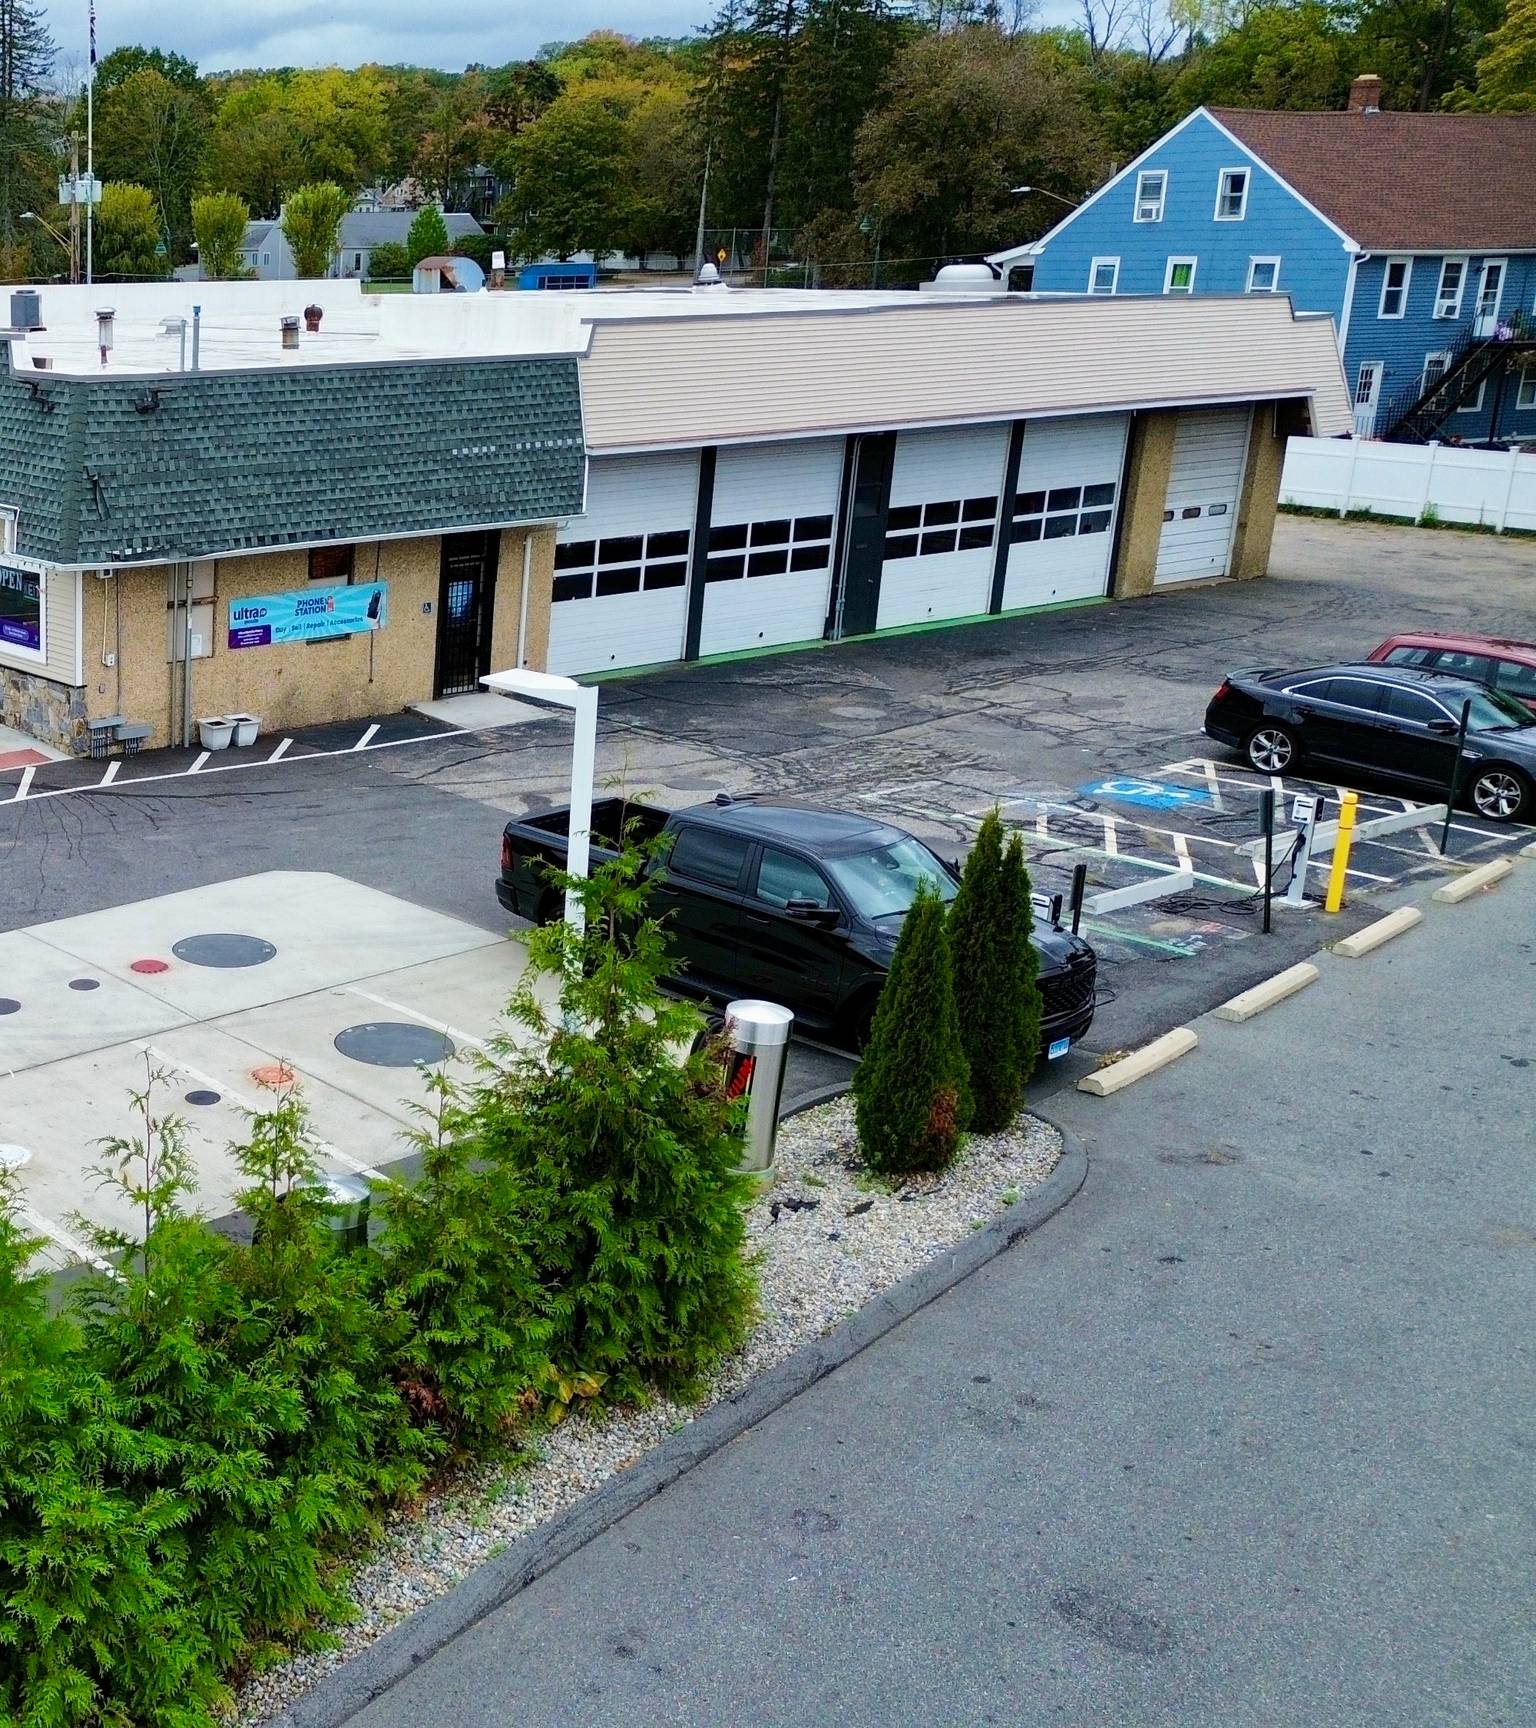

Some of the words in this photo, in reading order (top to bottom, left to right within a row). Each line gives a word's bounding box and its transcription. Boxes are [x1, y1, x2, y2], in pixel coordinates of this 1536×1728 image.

[296, 597, 325, 608] PHONE
[233, 607, 259, 621] ultra
[294, 606, 327, 617] STATION
